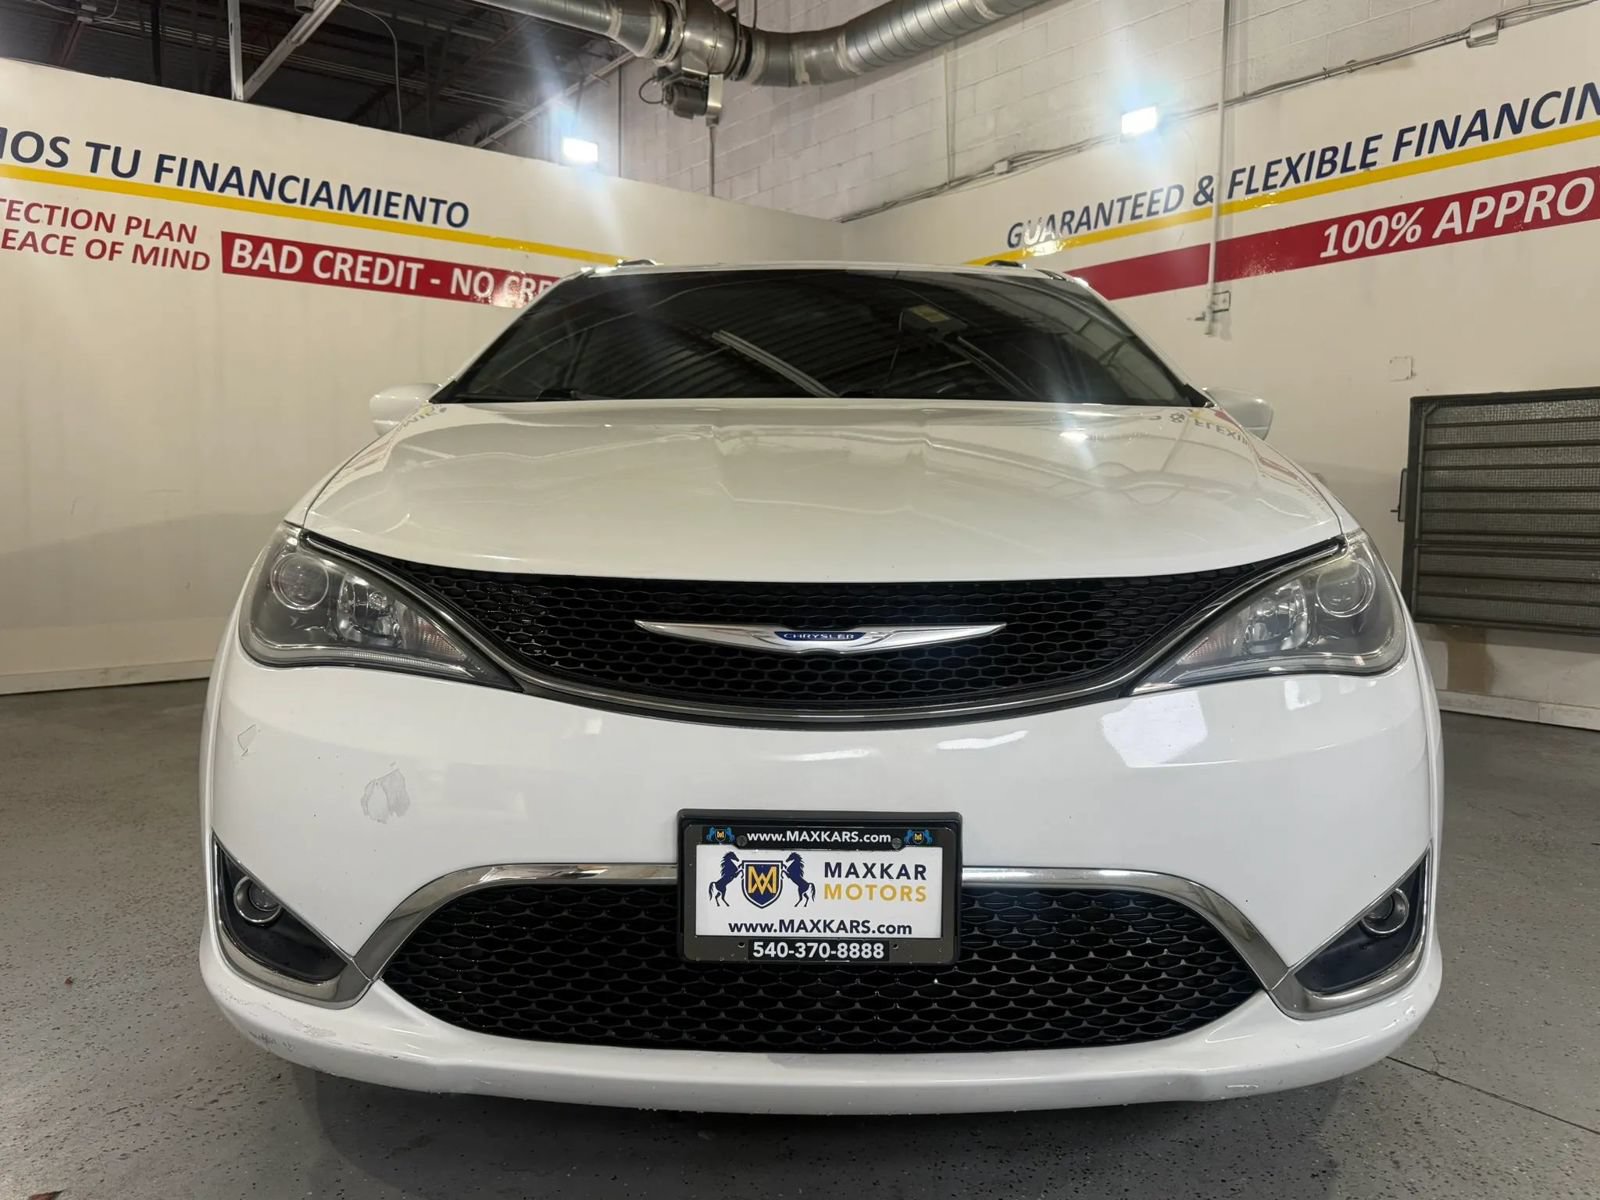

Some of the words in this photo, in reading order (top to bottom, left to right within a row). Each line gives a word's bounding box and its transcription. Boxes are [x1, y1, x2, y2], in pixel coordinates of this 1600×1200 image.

[85, 141, 141, 179] TU
[154, 154, 470, 228] FINANCIAMIENTO
[1007, 184, 1184, 248] GUARANTEED
[1193, 175, 1214, 206] &
[1227, 134, 1383, 199] FLEXIBLE
[124, 216, 198, 244] PLAN
[1320, 207, 1424, 258] 100%
[1432, 176, 1595, 240] APPRO
[85, 238, 124, 261] OF
[132, 244, 210, 271] MIND
[230, 238, 303, 274] BAD
[312, 249, 424, 290] CREDIT
[450, 268, 495, 297] NO
[747, 830, 892, 844] www.MAXKARS.com
[824, 862, 927, 881] MAXKAR
[824, 883, 927, 903] MOTORS
[728, 918, 912, 936] www.MAXKARS.com
[752, 941, 885, 959] 540-370-8888
